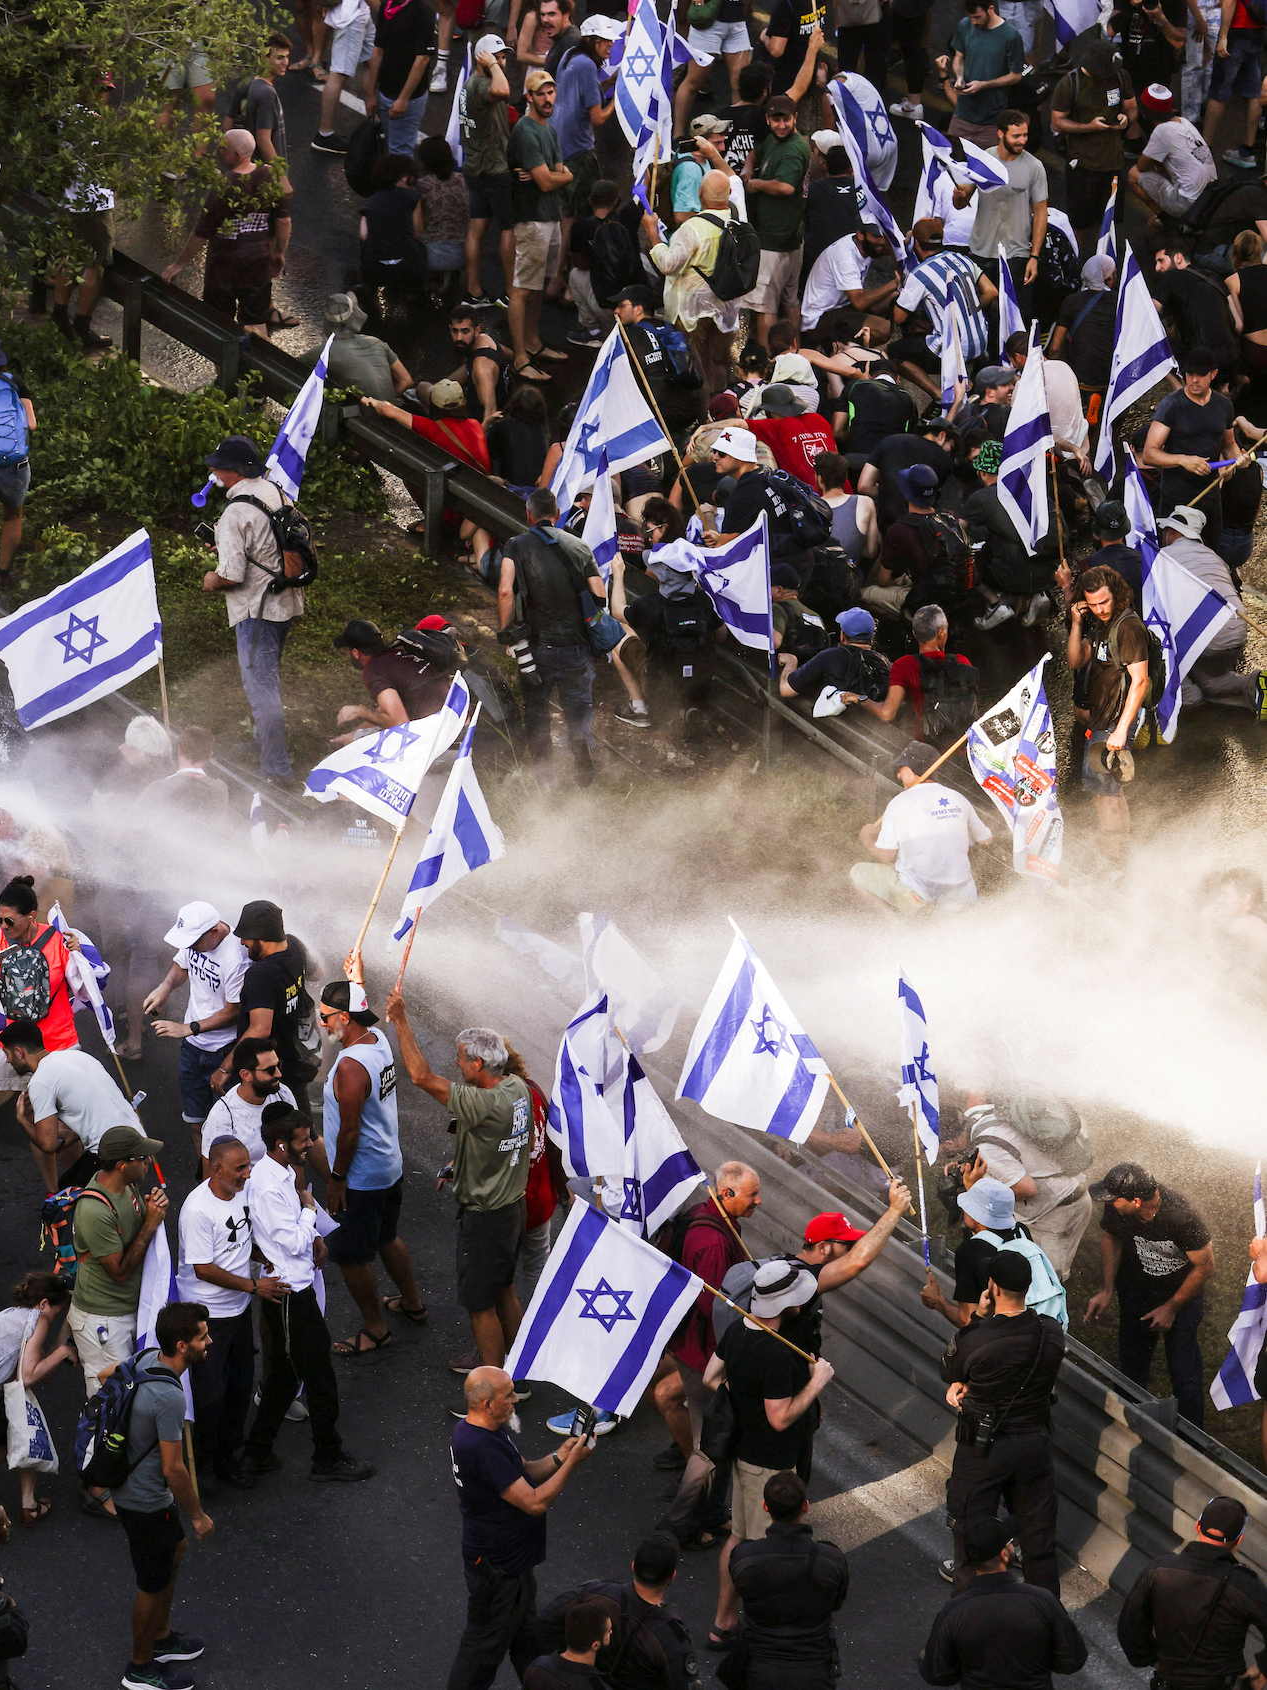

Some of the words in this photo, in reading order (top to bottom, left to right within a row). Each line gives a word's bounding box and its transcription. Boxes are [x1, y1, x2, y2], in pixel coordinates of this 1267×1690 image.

[378, 787, 406, 812] בארצנו
[386, 778, 411, 801] חופשי
[355, 819, 368, 828] אם
